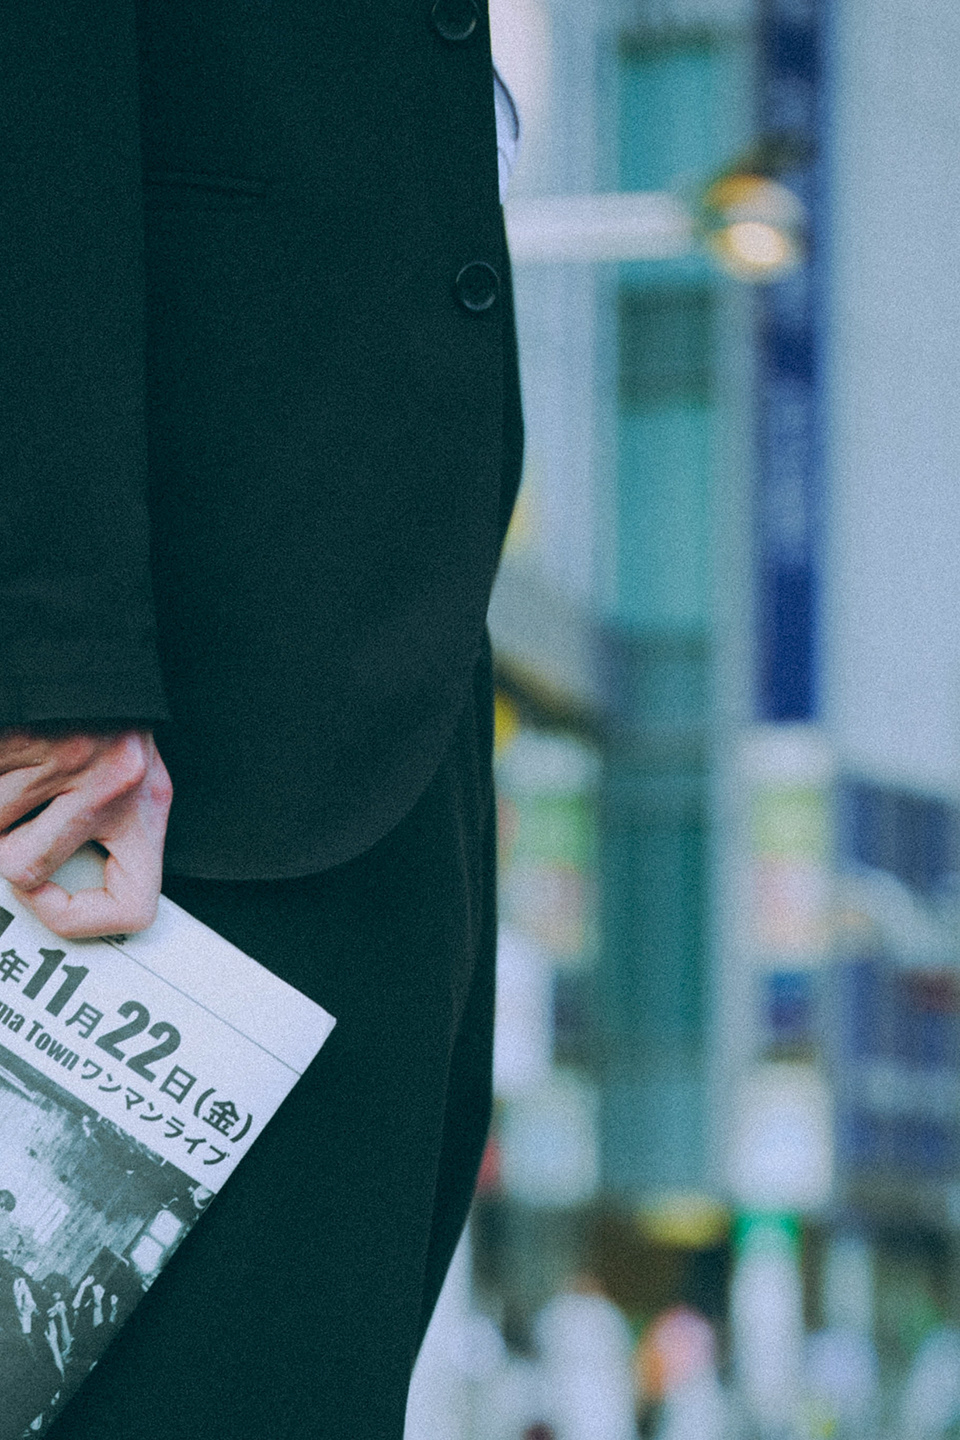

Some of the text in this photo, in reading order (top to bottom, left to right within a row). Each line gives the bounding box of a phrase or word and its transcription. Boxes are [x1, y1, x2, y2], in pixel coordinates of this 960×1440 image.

[25, 1019, 80, 1071] Town
[81, 1058, 231, 1166] ワンマンライブ
